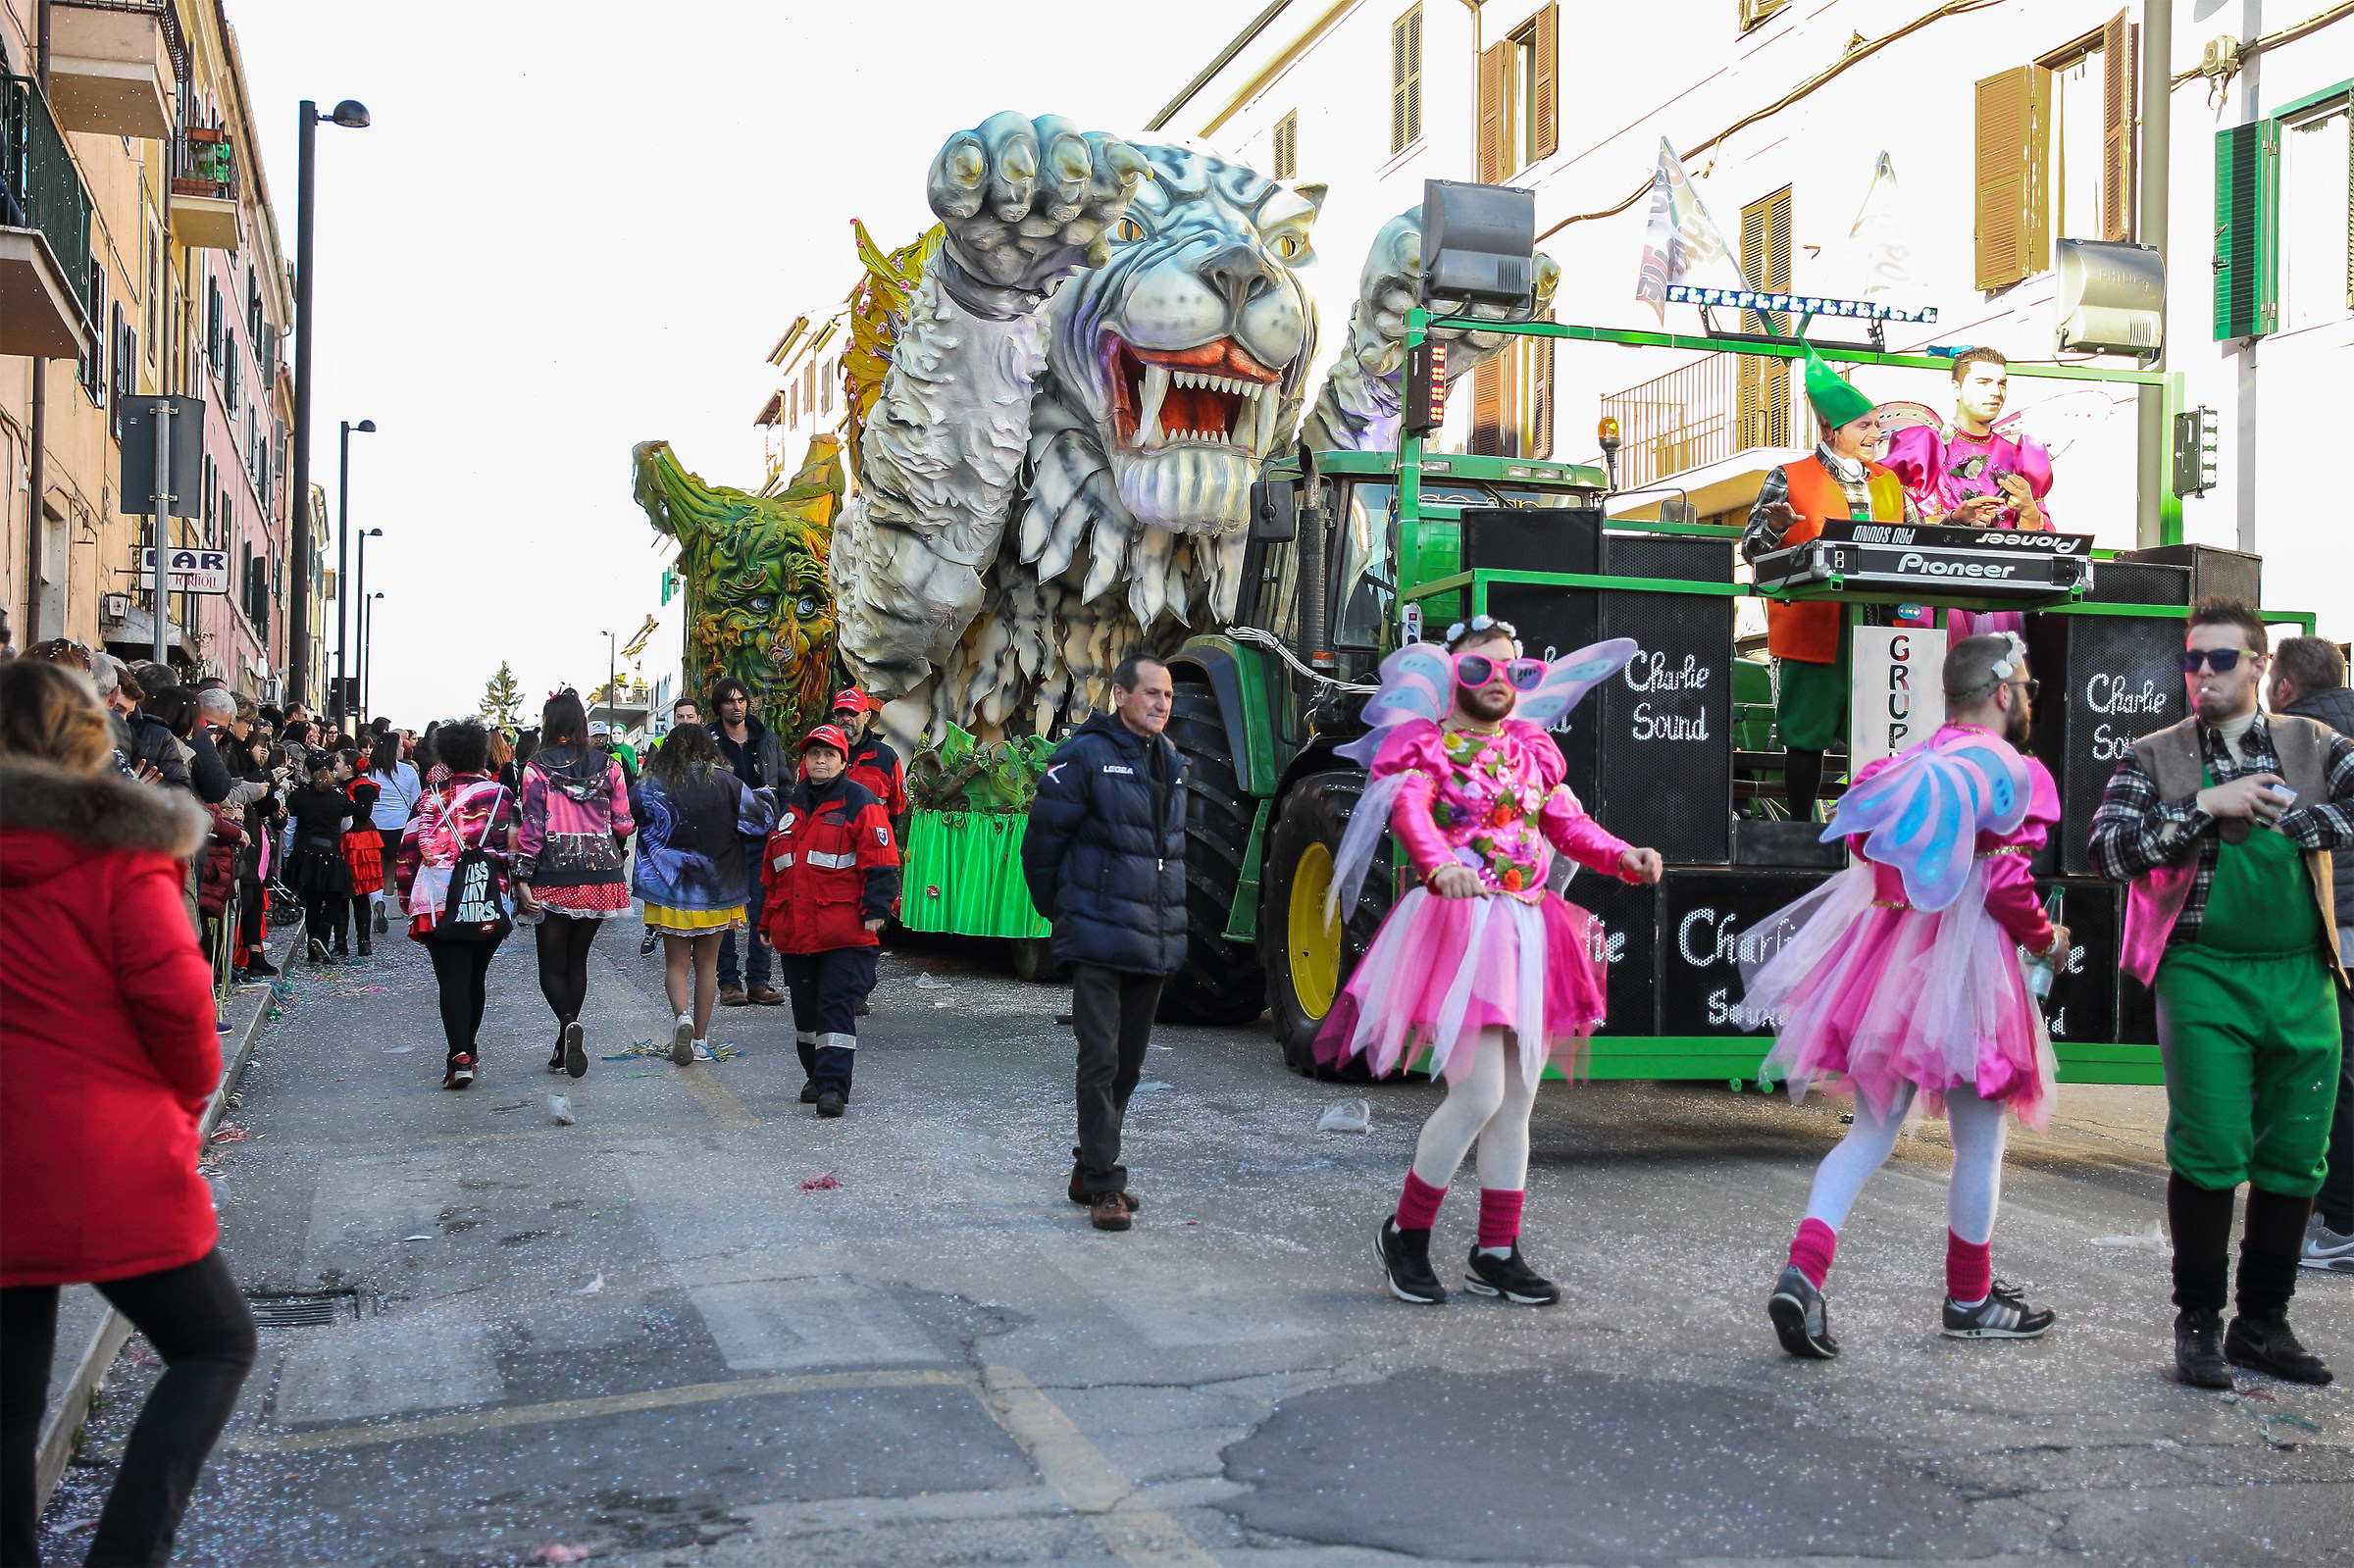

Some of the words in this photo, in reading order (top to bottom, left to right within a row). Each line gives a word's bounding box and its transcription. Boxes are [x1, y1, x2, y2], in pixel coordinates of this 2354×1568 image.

[1852, 525, 1892, 543] SOUND
[1892, 527, 1917, 544] PRO
[1974, 532, 2081, 554] Pioneer
[1897, 552, 2016, 579] Pioneer
[1625, 650, 1711, 692] Charlie
[1888, 634, 1910, 758] GRUP
[2087, 673, 2167, 715] Charlie
[1633, 702, 1710, 740] Sound
[454, 900, 500, 923] AIRS.
[1679, 908, 1795, 967] Charl
